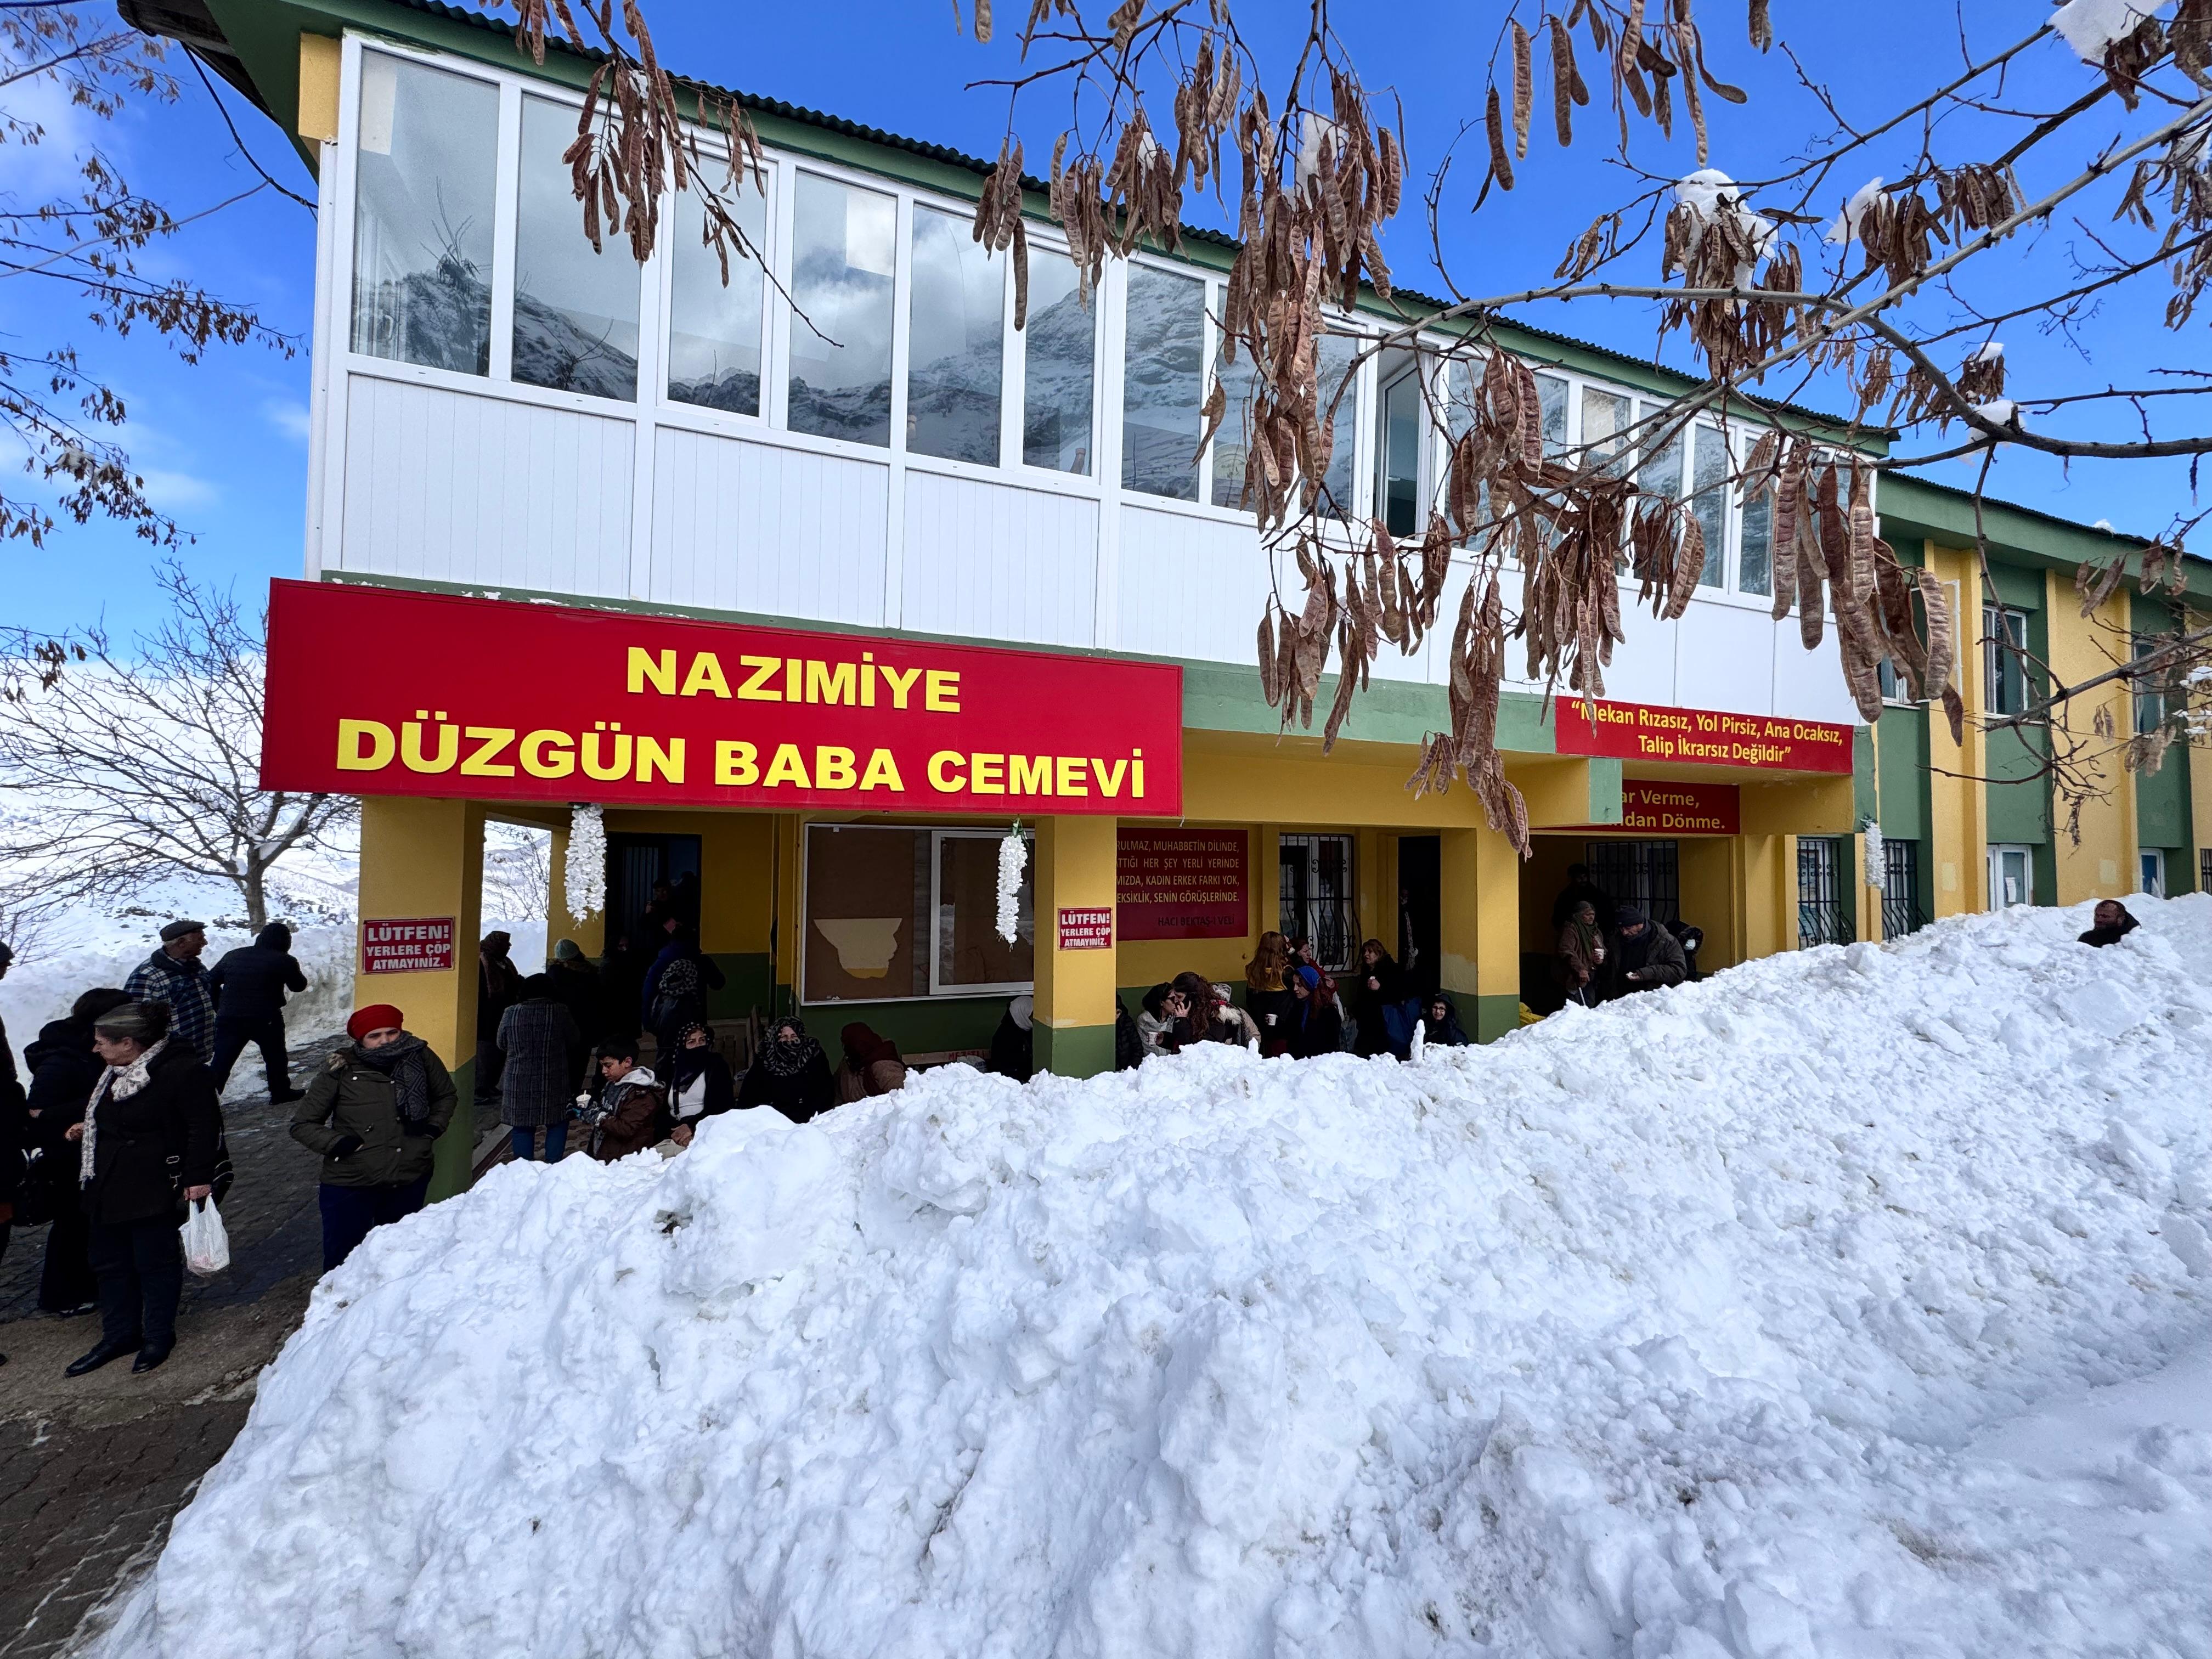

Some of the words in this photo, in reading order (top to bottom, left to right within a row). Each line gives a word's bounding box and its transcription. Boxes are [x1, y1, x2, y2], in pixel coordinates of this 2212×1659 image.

[627, 646, 960, 713] NAZIMİYE
[1639, 708, 1692, 733] Rızasız,
[1696, 714, 1718, 732] Yol
[1722, 716, 1760, 739] Pirsiz,
[1764, 721, 1790, 738] Ana
[1793, 724, 1842, 746] Ocaksız,
[336, 710, 686, 783] DÜZGÜN
[715, 740, 905, 791] BABA
[928, 748, 1144, 798] CEMEVİ
[1638, 735, 1674, 758] Talip
[1678, 733, 1729, 758] İkrarsız
[1733, 742, 1791, 764] Değildir”
[1640, 789, 1700, 809] Verme,
[1662, 813, 1725, 828] Dönme.
[1153, 839, 1206, 851] MUHABBETİN
[1208, 839, 1239, 853] DİLİNDE,
[1143, 858, 1159, 868] HER
[1164, 858, 1178, 870] ŞEY
[1183, 856, 1203, 868] YERLİ
[1207, 856, 1239, 868] YERİNDE
[1146, 876, 1171, 885] KADIN
[1173, 876, 1197, 885] ERKEK
[1199, 875, 1220, 885] FARKI
[1222, 876, 1239, 886] YOK,
[1154, 890, 1177, 902] SENİN
[1180, 890, 1239, 904] GÖRÜŞLERİNDE.
[1062, 911, 1110, 925] LÜTFEN!
[1158, 917, 1178, 926] HACI
[1217, 914, 1235, 925] VELİ
[368, 923, 449, 941] LÜTFEN!
[1061, 928, 1094, 936] YERLERE
[1096, 925, 1110, 938] ÇÖP
[366, 945, 422, 957] YERLERE
[426, 941, 451, 957] ÇÖP
